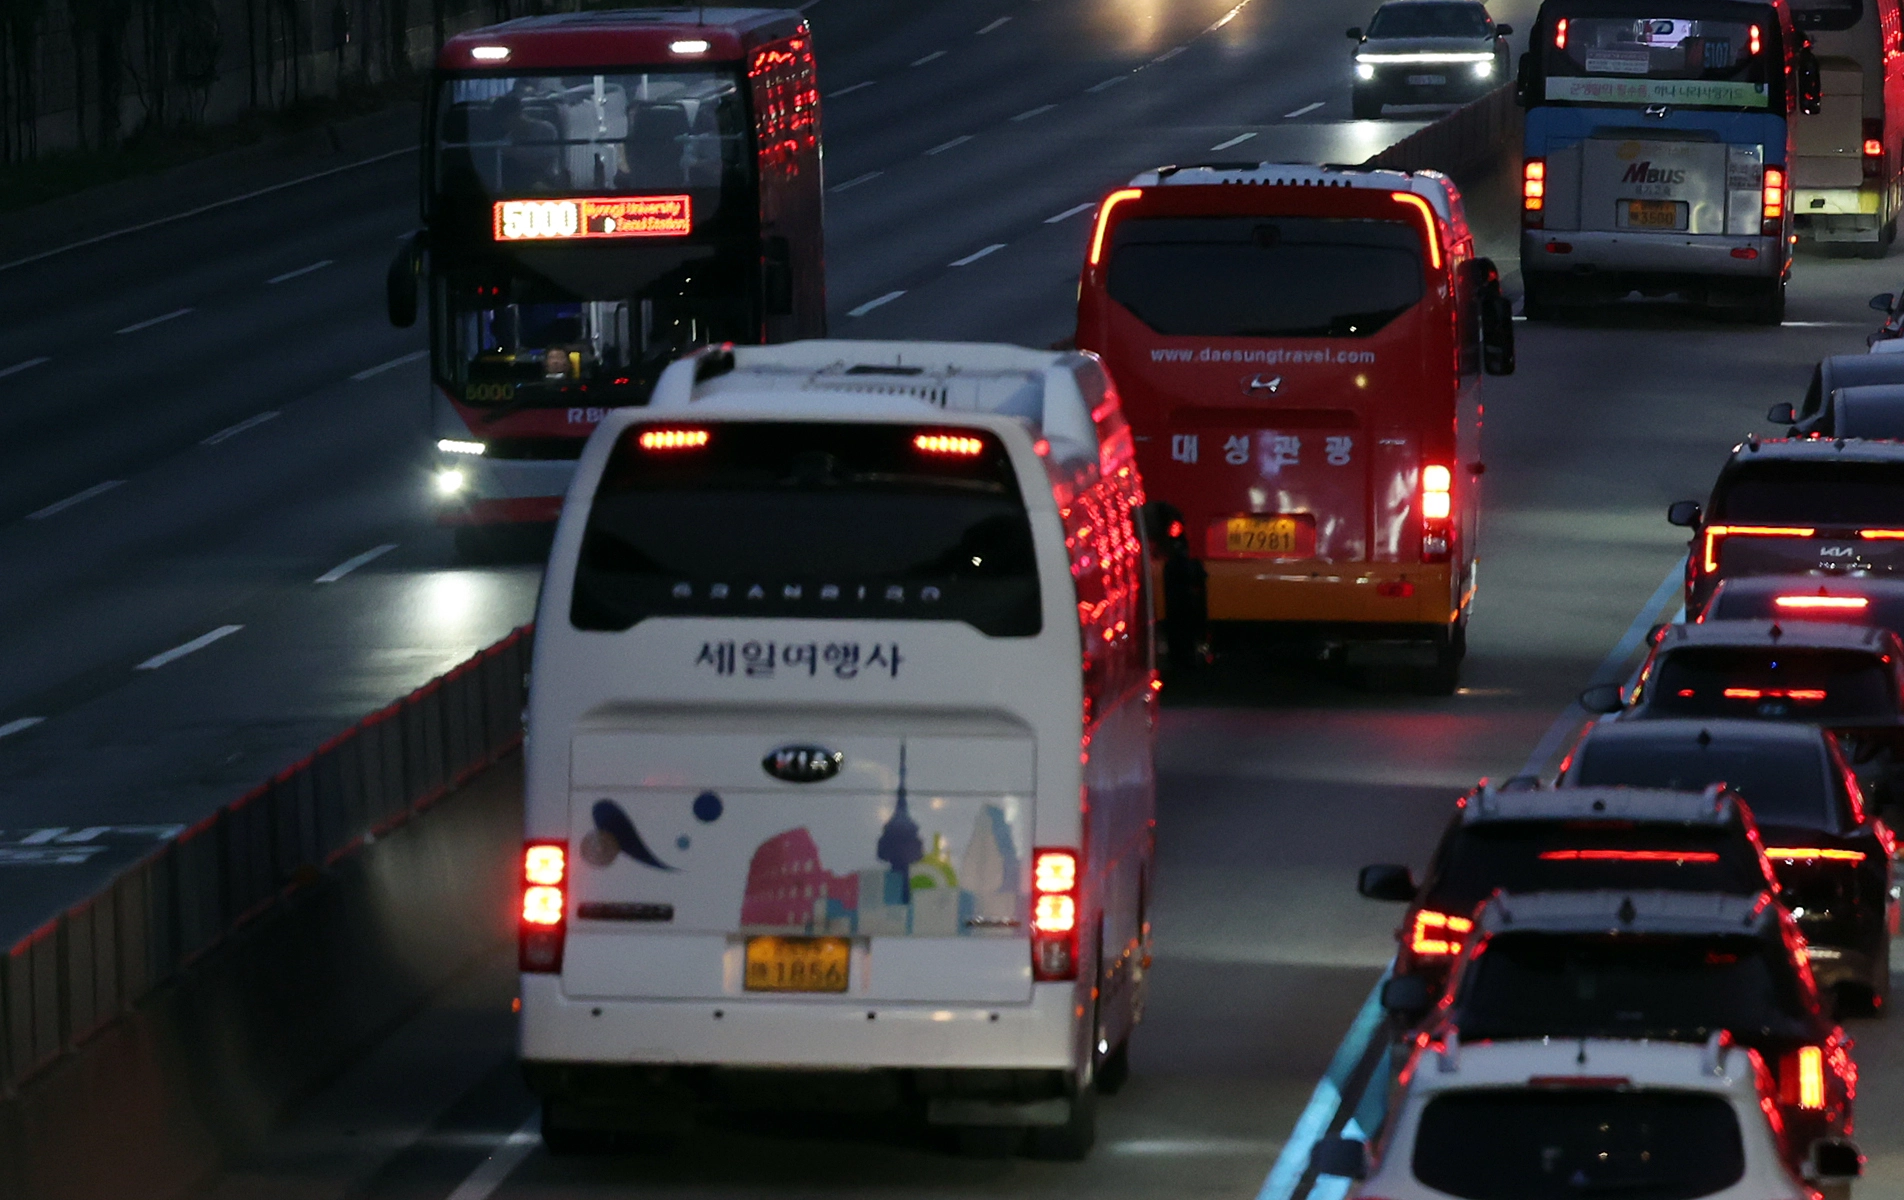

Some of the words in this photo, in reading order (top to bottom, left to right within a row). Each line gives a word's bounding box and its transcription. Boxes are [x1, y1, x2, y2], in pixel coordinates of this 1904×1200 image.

[1703, 41, 1730, 69] 5107
[503, 201, 578, 238] 5000
[1150, 347, 1376, 366] www.daesungtravel.com
[1820, 546, 1853, 557] KIA
[695, 640, 906, 679] 세일여행사
